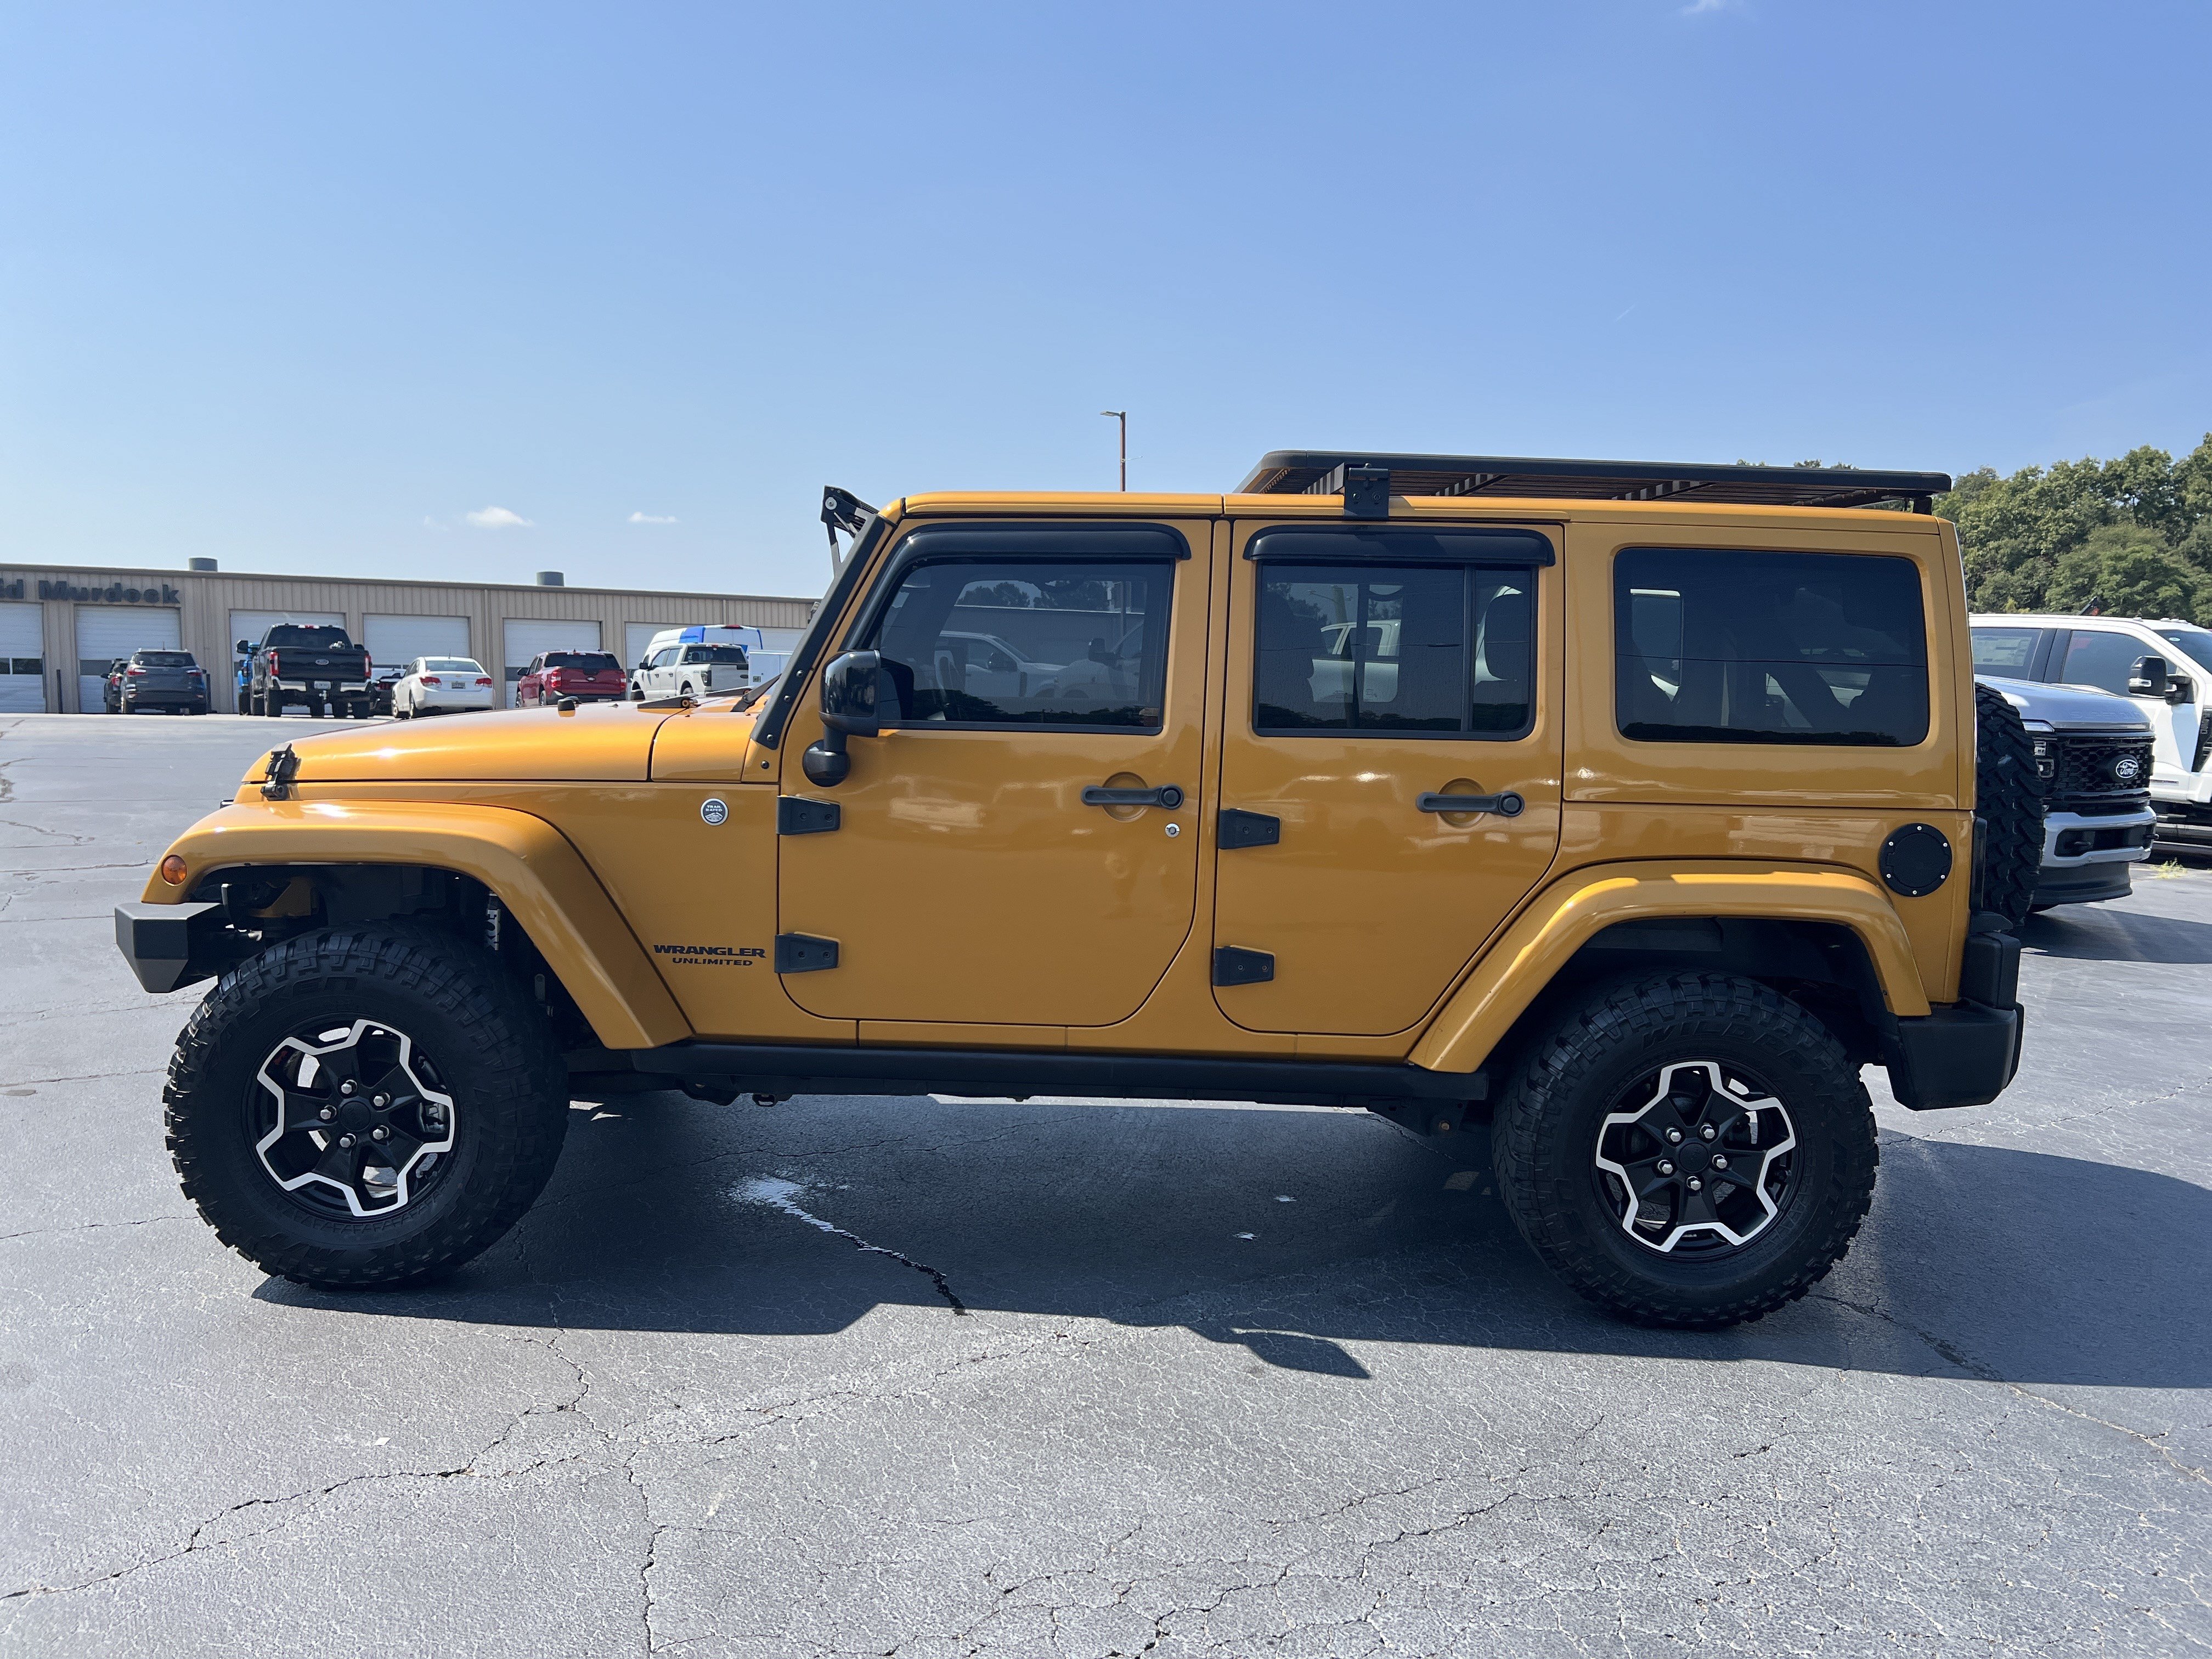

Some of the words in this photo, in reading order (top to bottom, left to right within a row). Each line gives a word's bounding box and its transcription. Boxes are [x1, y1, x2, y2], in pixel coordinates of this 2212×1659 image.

[38, 579, 180, 604] Murdock
[486, 909, 501, 951] FOX
[653, 945, 766, 958] WRANGLER
[672, 957, 753, 966] UNLIMITED
